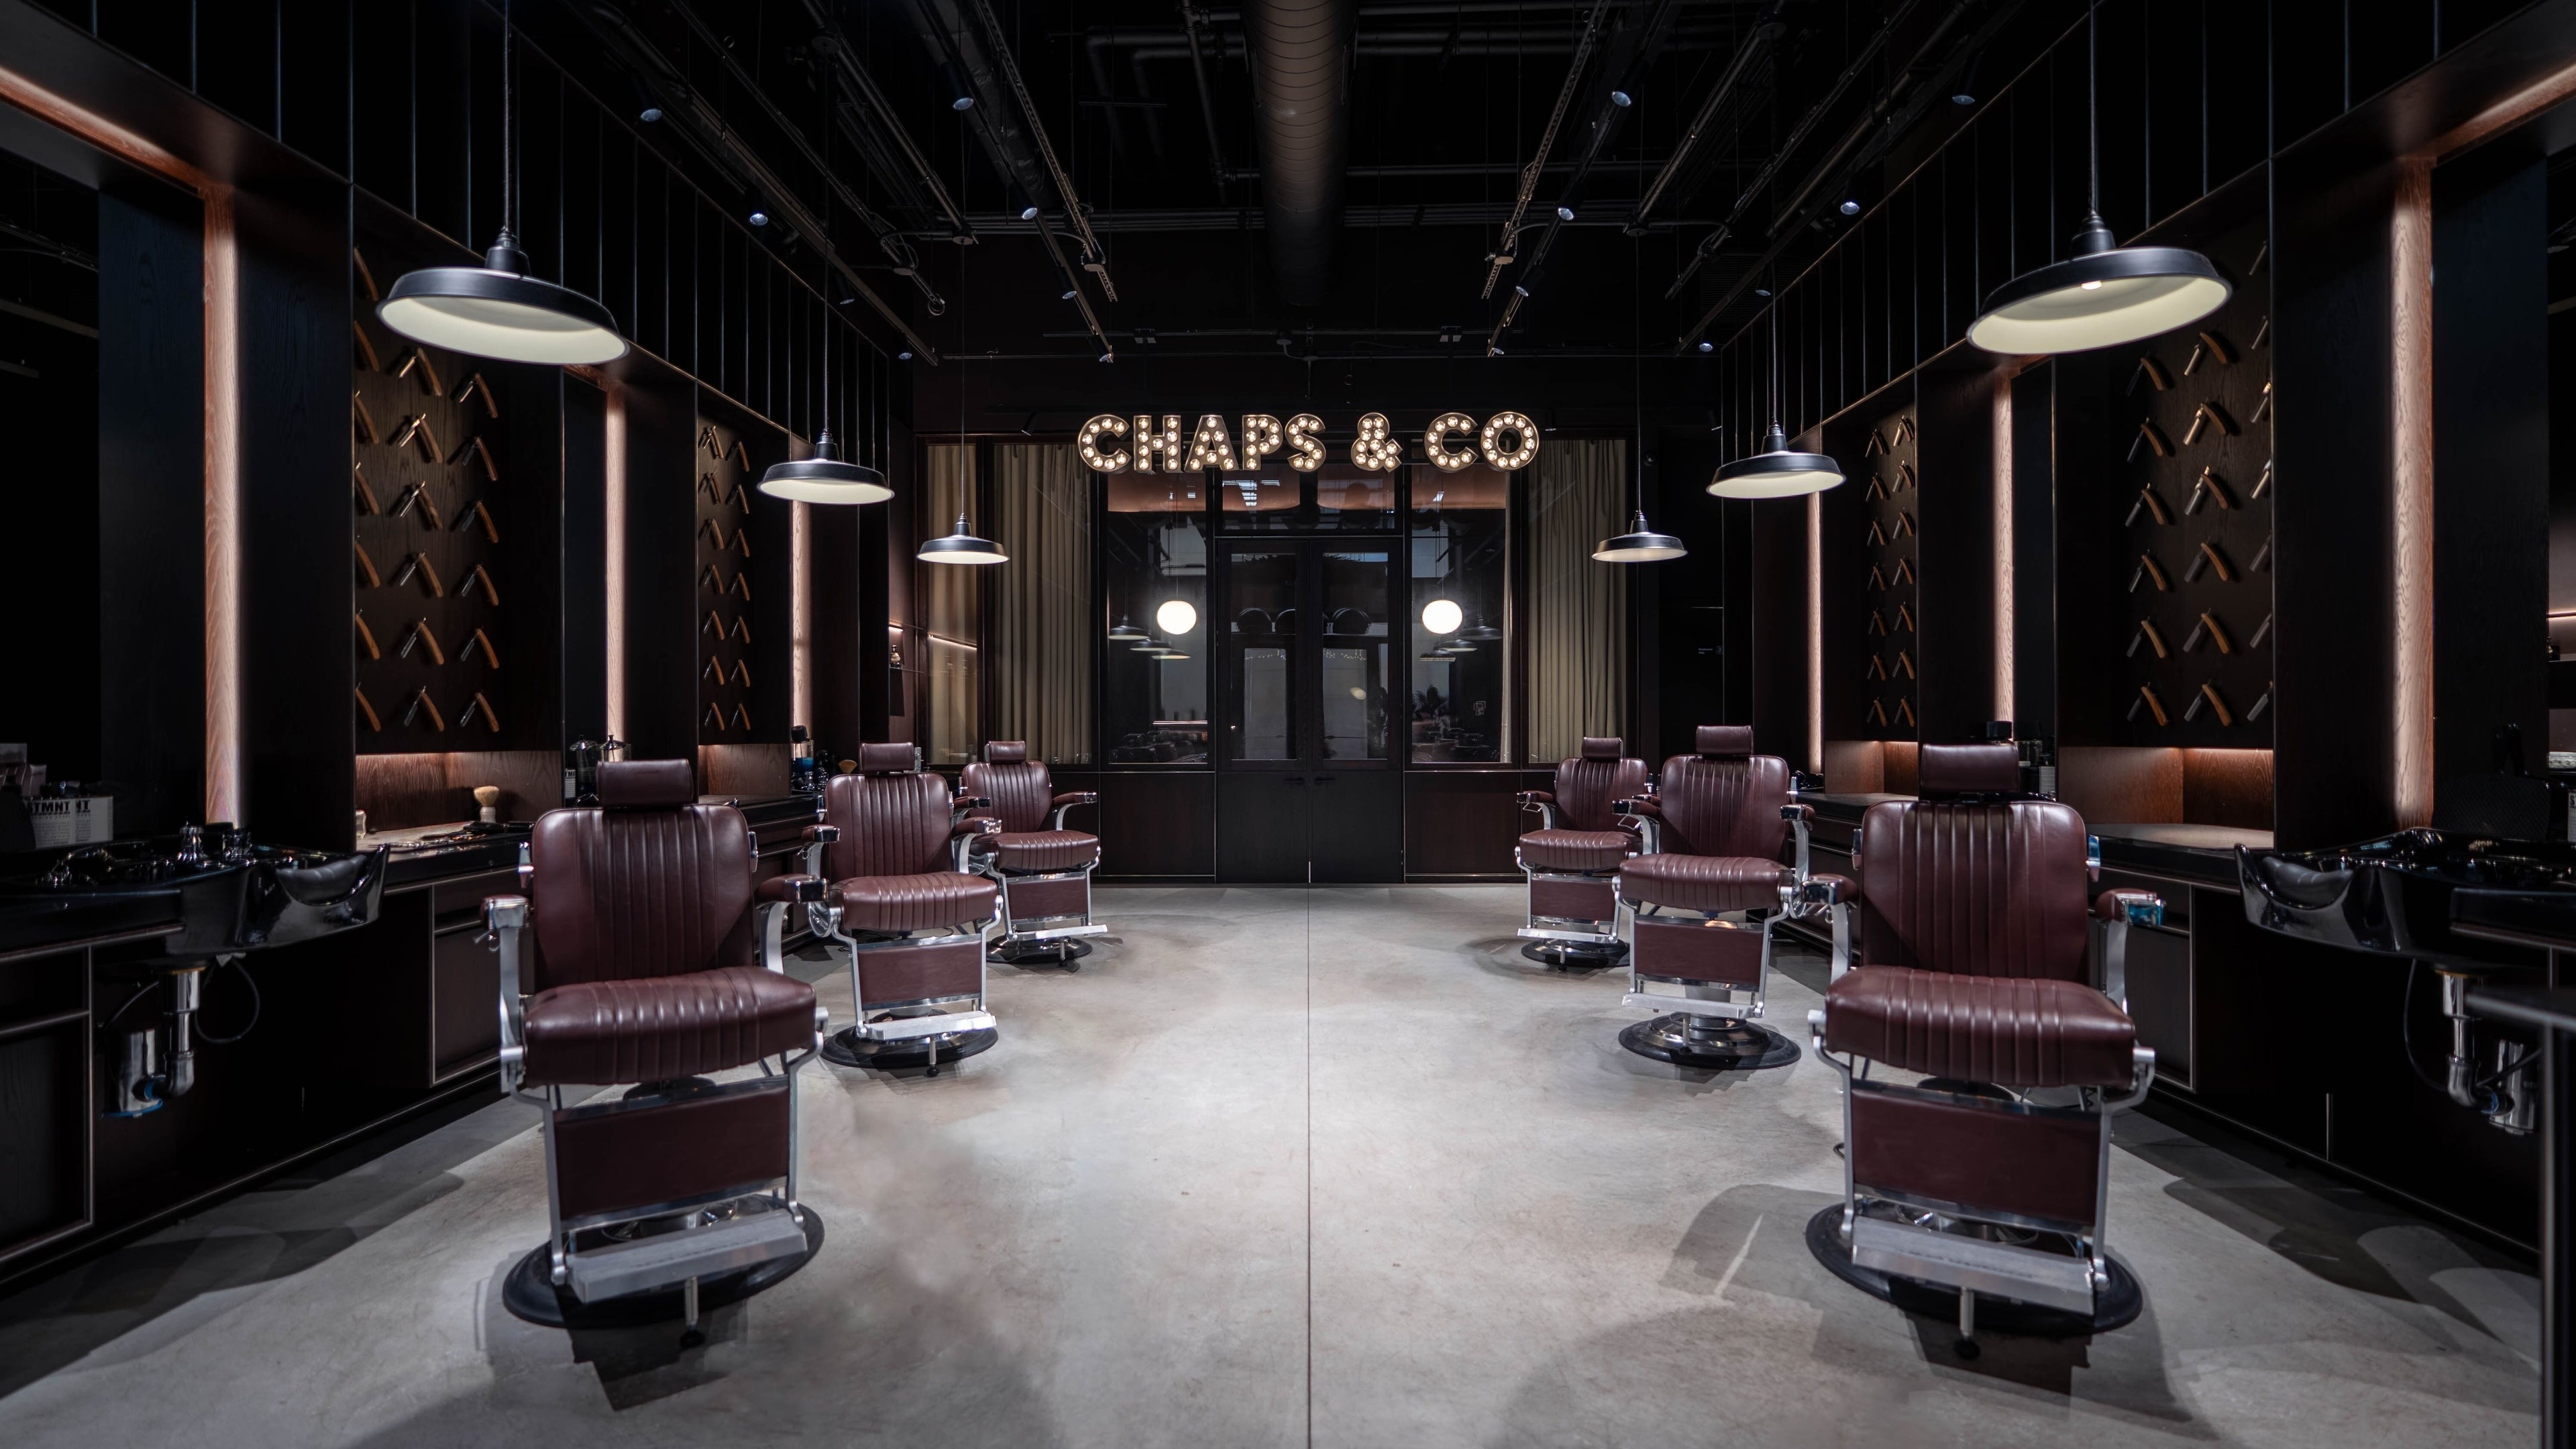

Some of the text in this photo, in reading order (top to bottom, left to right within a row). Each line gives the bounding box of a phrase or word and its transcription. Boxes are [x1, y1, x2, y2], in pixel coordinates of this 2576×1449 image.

[1077, 412, 1539, 473] CHAPS & CO
